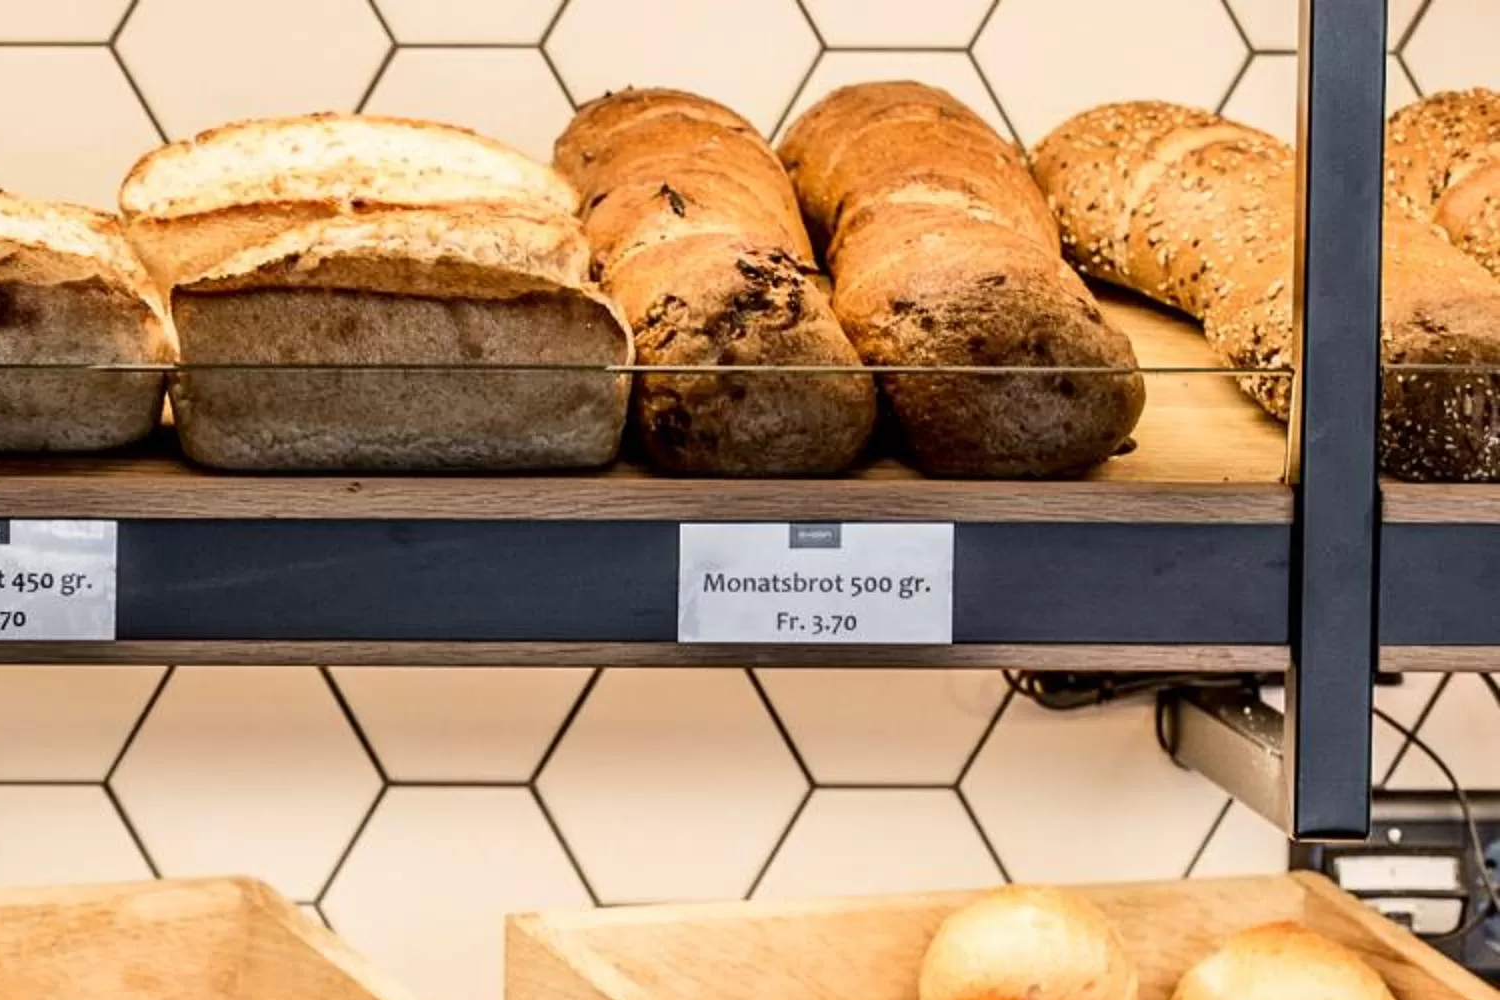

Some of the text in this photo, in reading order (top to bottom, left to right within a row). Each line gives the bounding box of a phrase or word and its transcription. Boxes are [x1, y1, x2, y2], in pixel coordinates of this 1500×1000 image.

[11, 572, 54, 593] 450
[60, 572, 92, 596] gr.
[703, 572, 931, 599] Monatsbrot 500 gr.
[777, 612, 857, 635] Fr. 3.70
